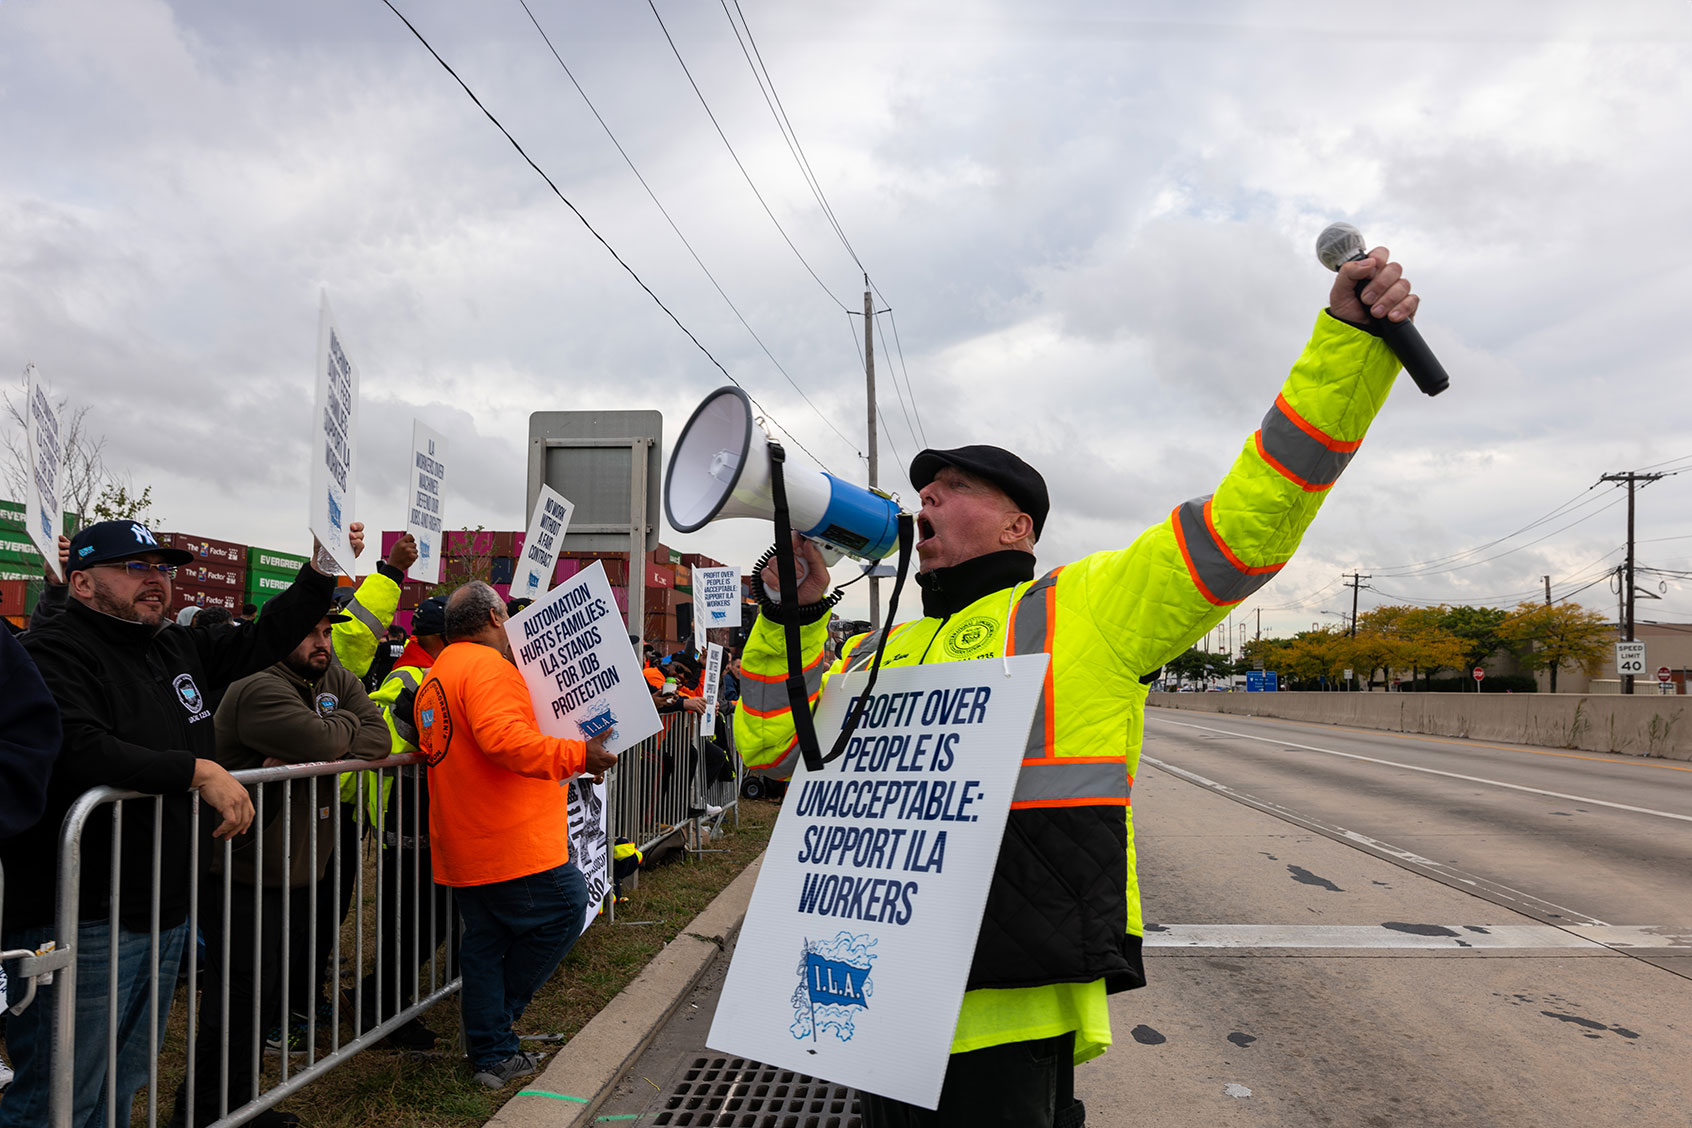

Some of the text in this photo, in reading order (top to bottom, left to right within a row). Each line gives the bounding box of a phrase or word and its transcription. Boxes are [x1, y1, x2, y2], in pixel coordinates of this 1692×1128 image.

[540, 513, 562, 536] WITHOUT
[544, 497, 566, 522] NO WORK
[186, 543, 198, 552] The
[210, 547, 228, 556] Factor
[528, 544, 552, 568] CONTRACT
[185, 568, 197, 576] The
[208, 572, 226, 580] Factor
[184, 594, 195, 602] The
[522, 582, 592, 640] AUTOMATION
[520, 598, 610, 666] HURTS FAMILIES:
[540, 626, 602, 678] ILA STANDS
[555, 652, 600, 692] FOR JOB
[1621, 661, 1642, 671] 40
[552, 665, 620, 719] PROTECTION
[921, 686, 992, 726] OVER
[840, 732, 960, 772] PEOPLE IS
[796, 780, 984, 822] UNACCEPTABLE:
[798, 824, 948, 874] SUPPORT ILA
[798, 872, 918, 926] WORKERS
[814, 964, 861, 999] I.L.A.
